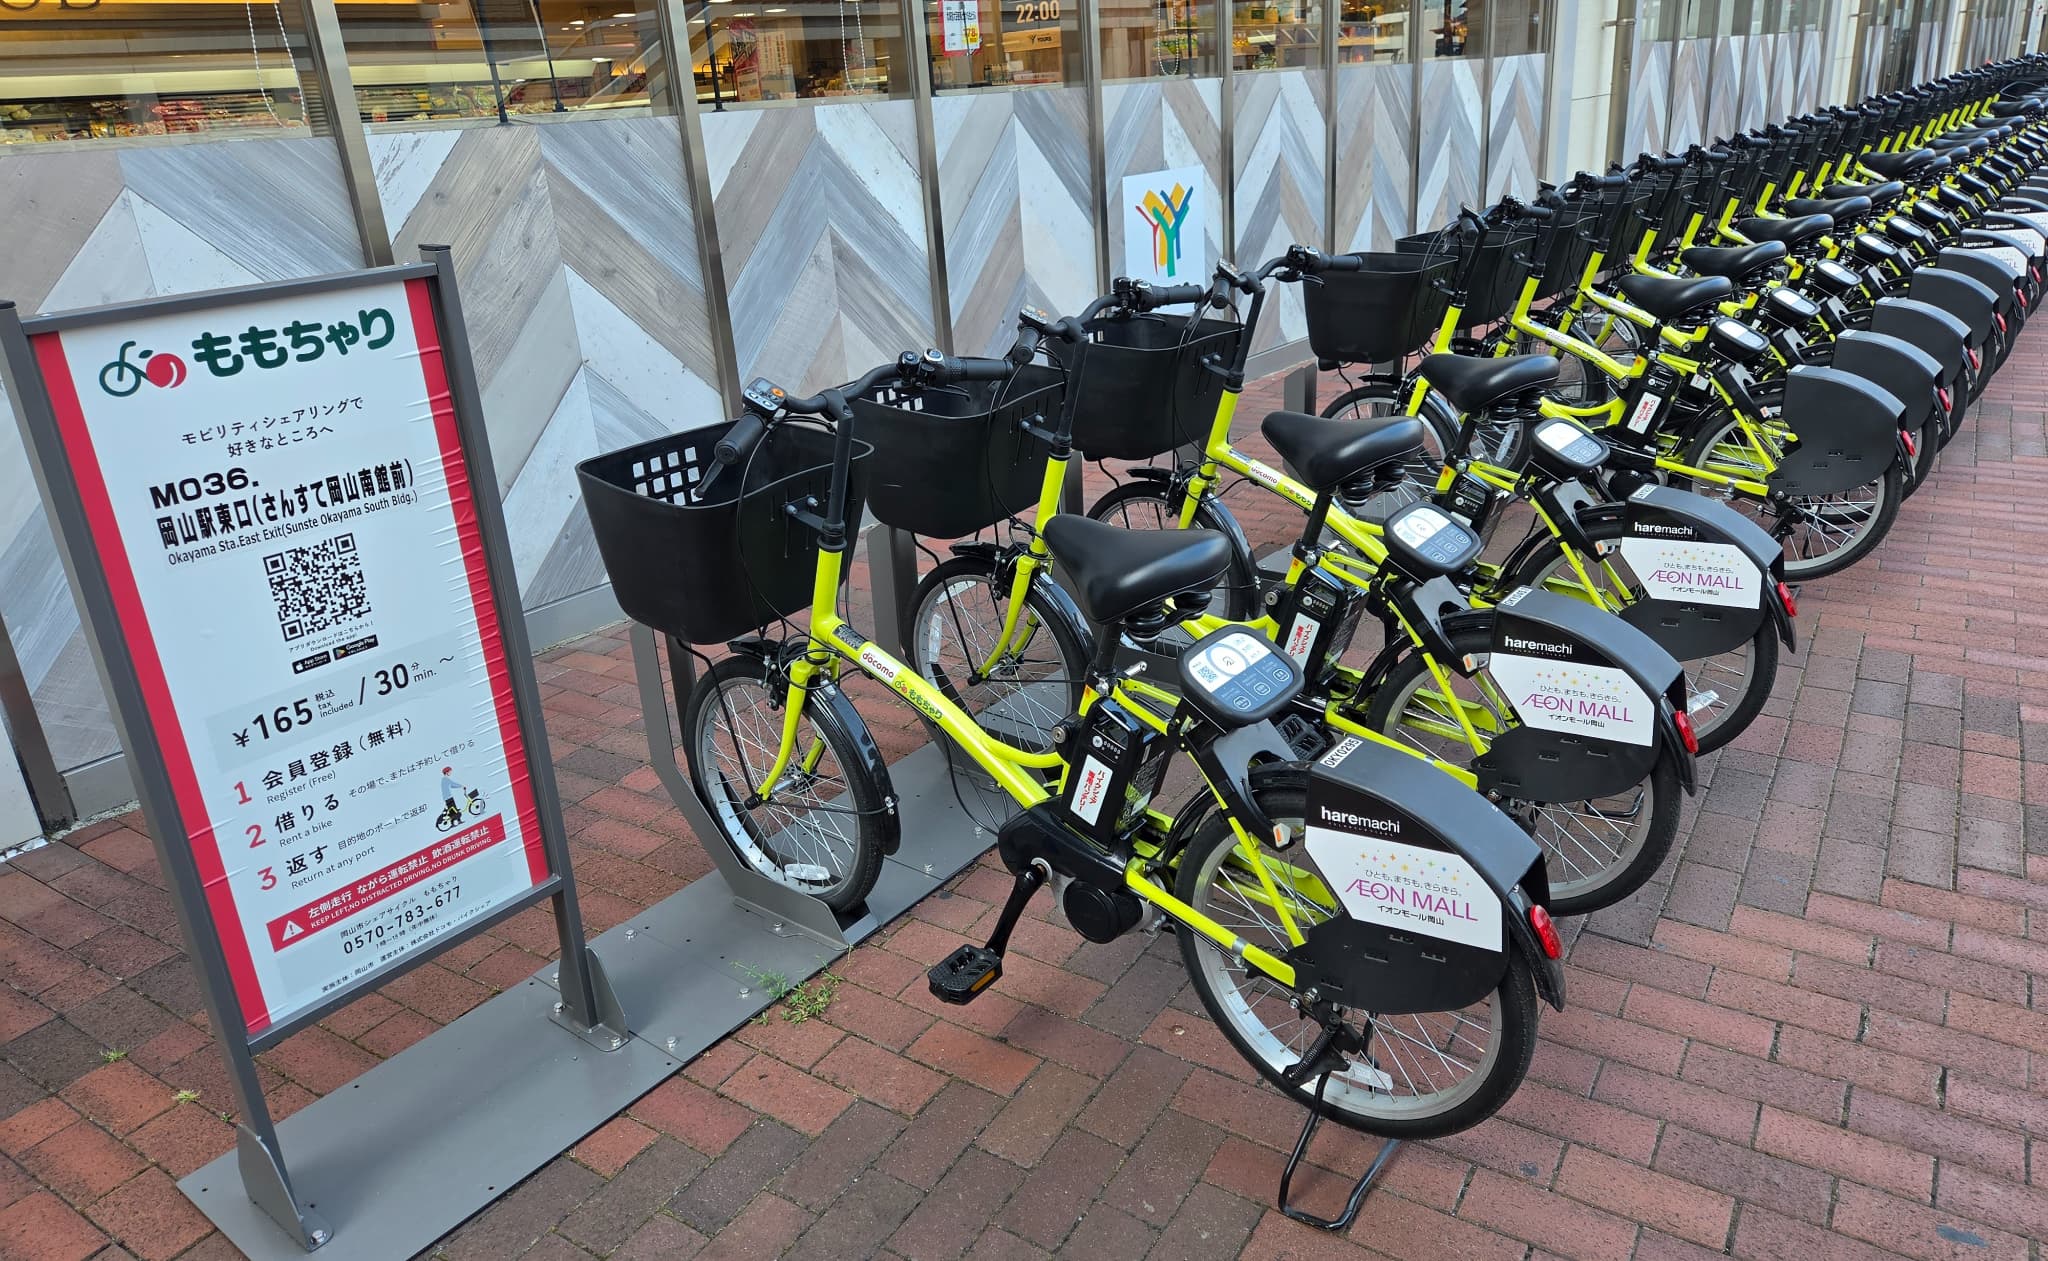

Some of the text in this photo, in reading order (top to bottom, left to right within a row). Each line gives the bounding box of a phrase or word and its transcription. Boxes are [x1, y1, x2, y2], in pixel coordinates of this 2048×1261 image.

[1016, 0, 1060, 24] 22:00
[192, 308, 395, 377] ももちゃり
[181, 396, 364, 446] モビリティシェアリングで
[226, 426, 334, 458] 好きなところへ
[168, 544, 217, 566] Okayama
[320, 507, 362, 526] Okayama
[364, 498, 390, 514] South
[1634, 522, 1693, 535] haremachi
[1697, 574, 1744, 590] MALL
[1505, 636, 1573, 655] haremachi
[862, 652, 894, 679] docomo
[314, 689, 335, 702] 税込
[317, 701, 332, 711] tax
[319, 700, 354, 718] included
[909, 690, 943, 720] ももちゃり
[1579, 701, 1633, 723] MALL
[1324, 739, 1360, 768] OKY0295
[233, 780, 252, 805] 1
[267, 769, 336, 805] Register (Free)
[274, 793, 340, 833] 借りる
[1321, 806, 1400, 834] haremachi
[245, 824, 266, 848] 2
[279, 831, 302, 848] Rent
[313, 818, 333, 834] bike
[285, 845, 328, 876] 返す
[291, 846, 375, 889] Return at any port
[257, 866, 277, 891] 3
[308, 890, 352, 919] 左側走行
[357, 855, 429, 895] ながら運転禁止
[310, 917, 331, 928] KEEP
[361, 881, 403, 907] DISTRACTED
[442, 850, 465, 866] DRUNK
[465, 837, 492, 855] DRIVING
[424, 876, 457, 896] ももちゃり
[344, 885, 462, 954] 0570-783-677
[1377, 905, 1445, 926] イオンモール岡山
[1412, 891, 1478, 922] MALL
